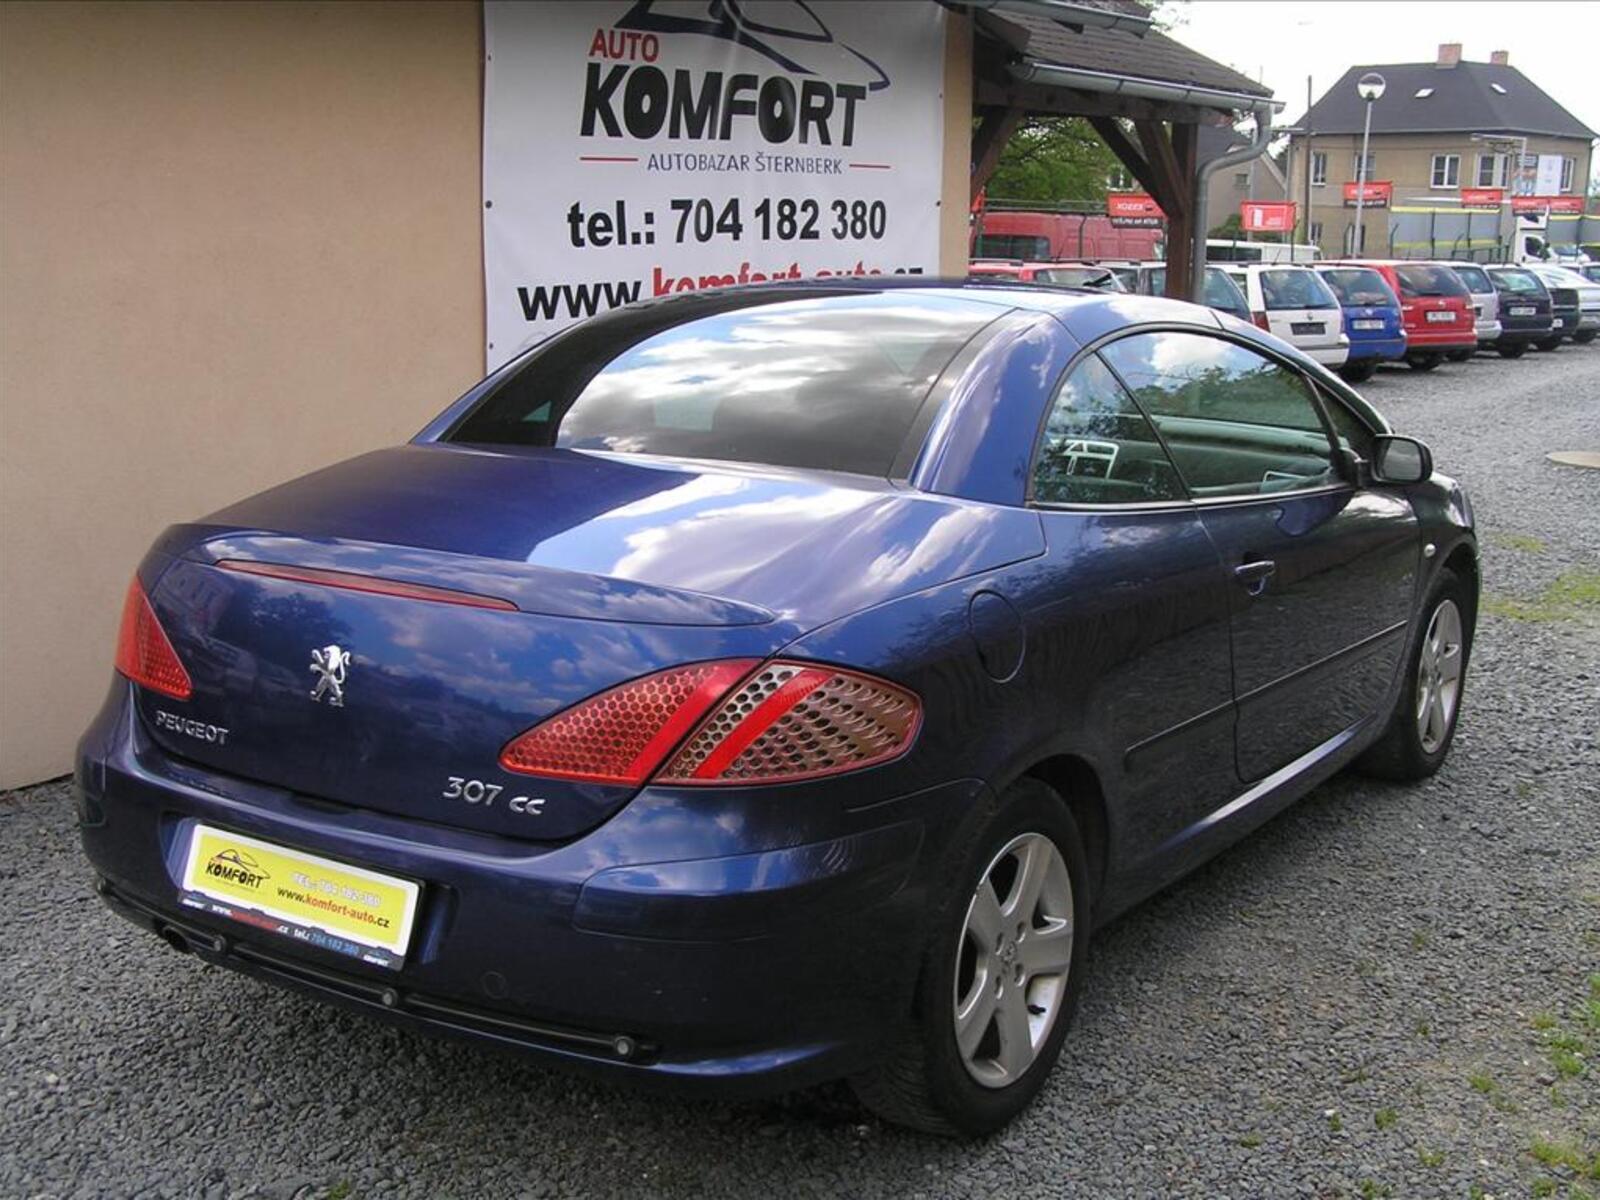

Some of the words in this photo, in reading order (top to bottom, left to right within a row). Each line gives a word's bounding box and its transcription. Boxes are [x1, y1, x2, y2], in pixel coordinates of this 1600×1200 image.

[589, 27, 660, 63] AUTO
[580, 62, 867, 147] KOMFORT
[647, 153, 750, 172] AUTOBAZAR
[755, 151, 843, 175] ŠTERNBERK
[567, 200, 655, 248] tel.:
[670, 198, 743, 243] 704
[754, 198, 820, 240] 182
[831, 199, 887, 240] 380
[156, 710, 229, 745] PEUGEOT
[442, 776, 503, 805] 307
[205, 862, 264, 888] KOMFORT
[277, 886, 390, 928] www.komfort-auto.cz
